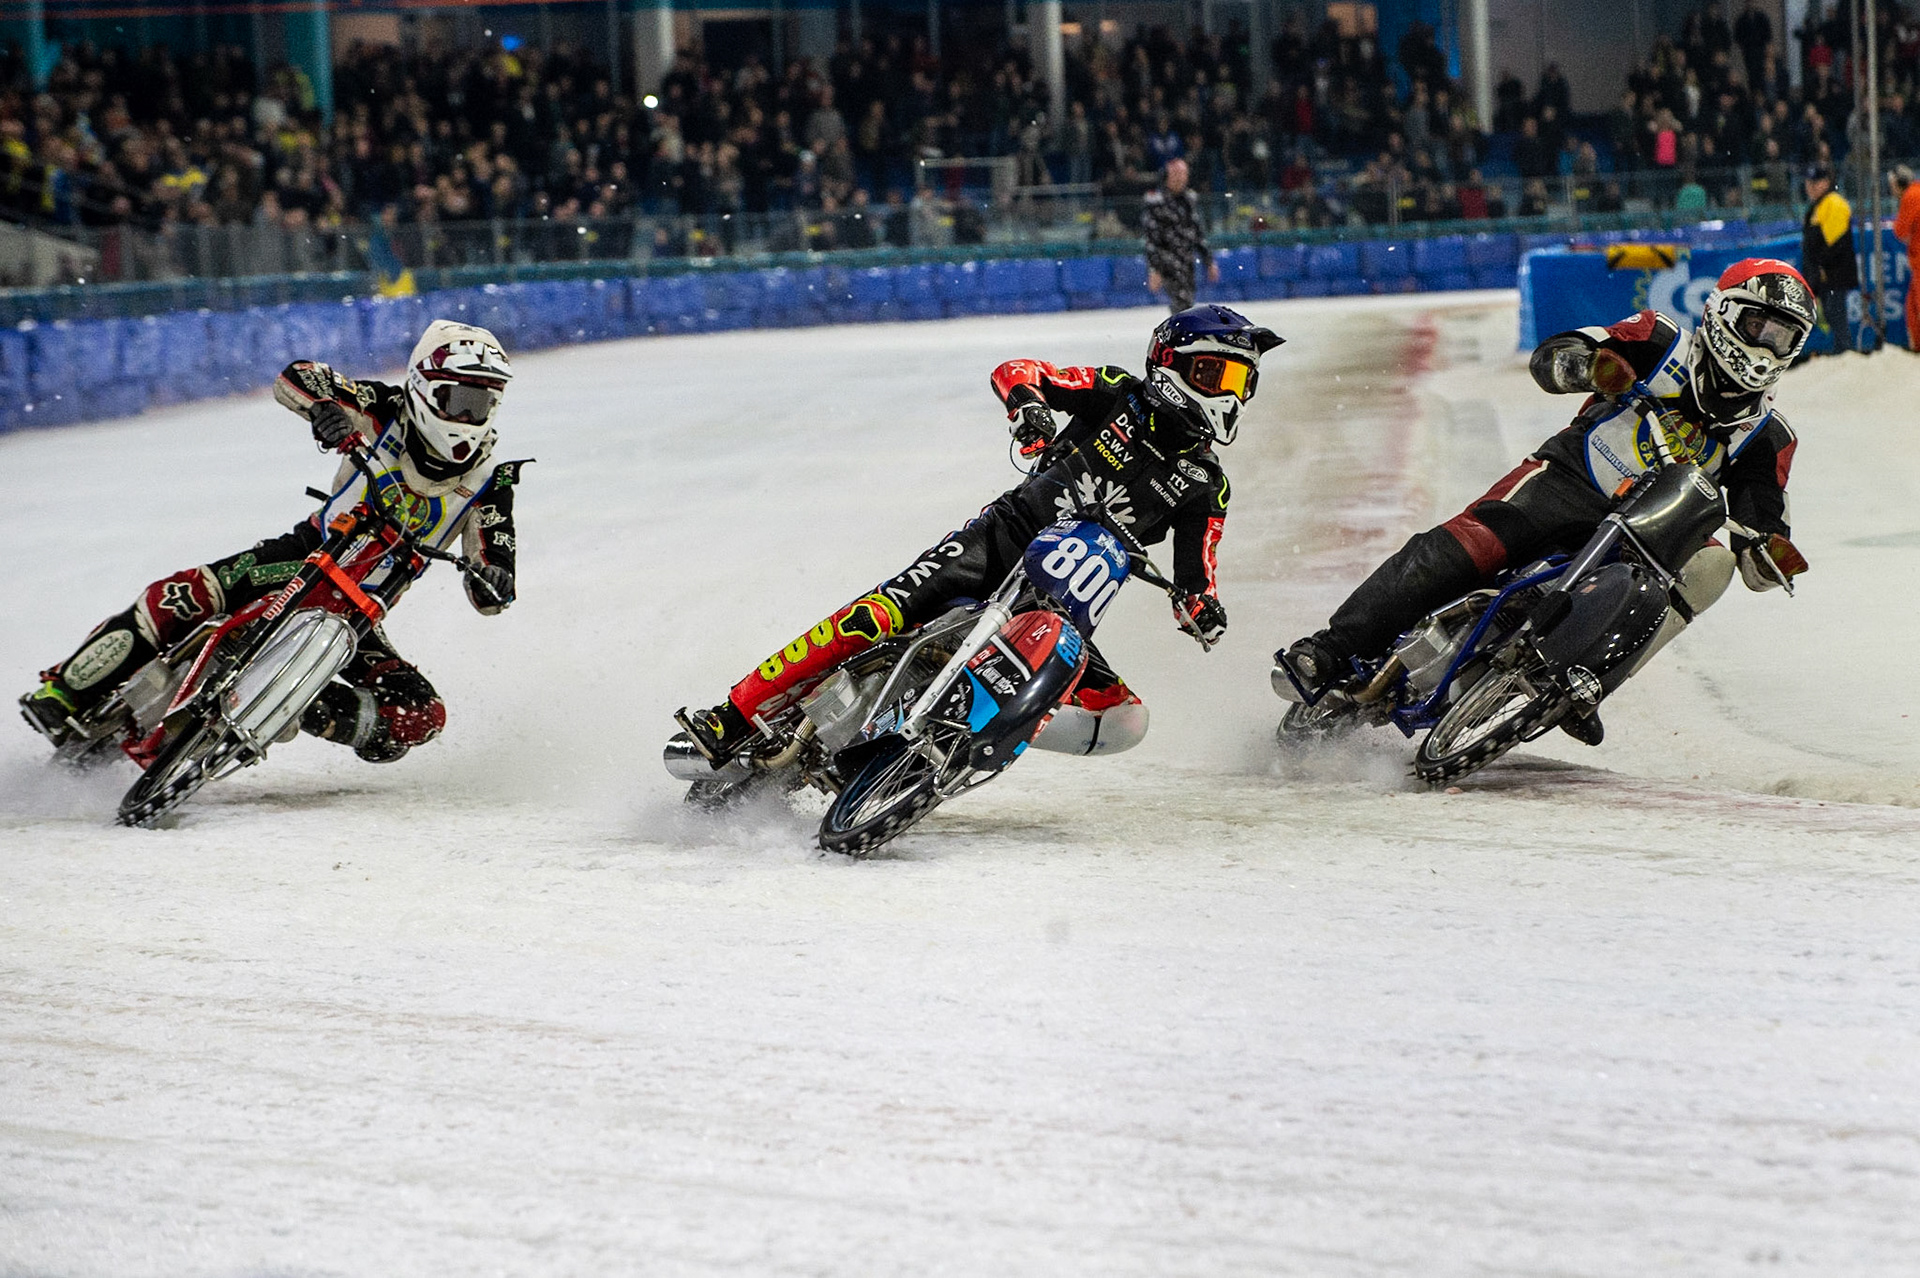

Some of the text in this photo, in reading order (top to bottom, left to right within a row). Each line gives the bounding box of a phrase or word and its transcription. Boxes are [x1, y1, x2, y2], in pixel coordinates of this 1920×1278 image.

[1093, 439, 1124, 471] TROOST
[1150, 478, 1177, 508] WEIJERS
[1169, 473, 1190, 490] rtv
[886, 541, 965, 608] C.W.V
[1041, 536, 1119, 627] 800
[1577, 671, 1599, 694] JAWA
